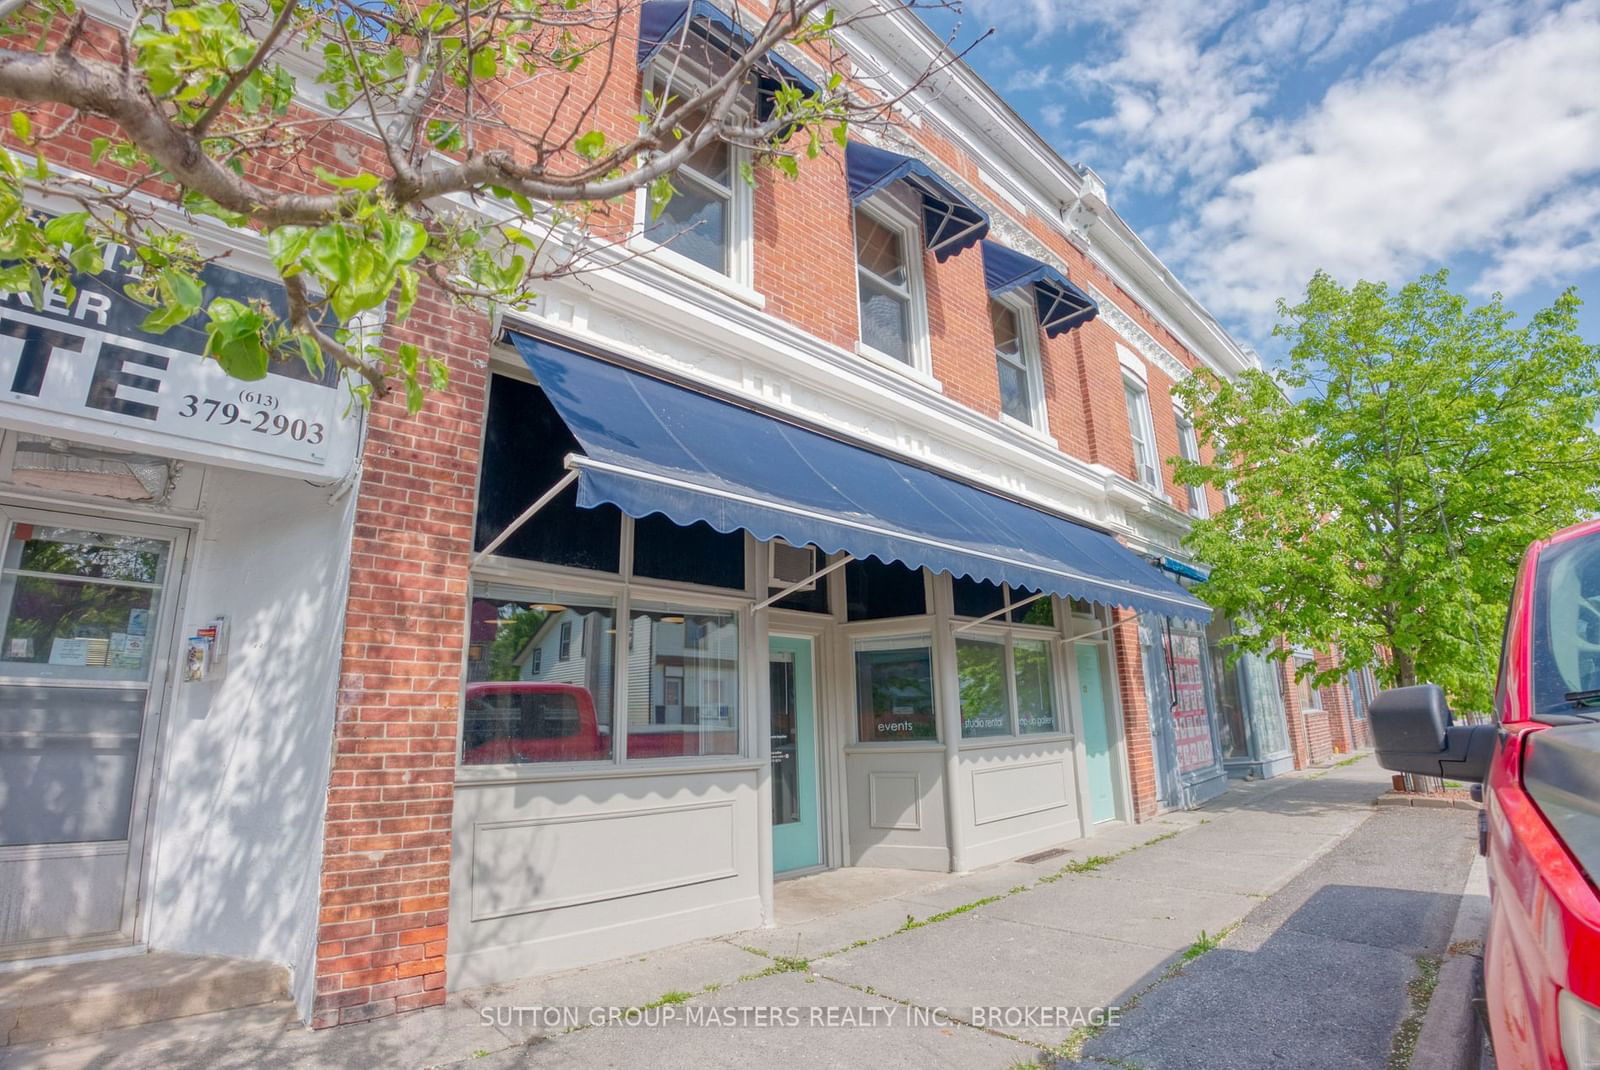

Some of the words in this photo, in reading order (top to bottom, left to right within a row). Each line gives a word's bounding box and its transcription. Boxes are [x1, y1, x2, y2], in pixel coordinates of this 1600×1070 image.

[239, 389, 279, 410] (613)
[178, 395, 325, 444] 379-2903
[878, 720, 913, 732] events
[964, 718, 984, 729] studio
